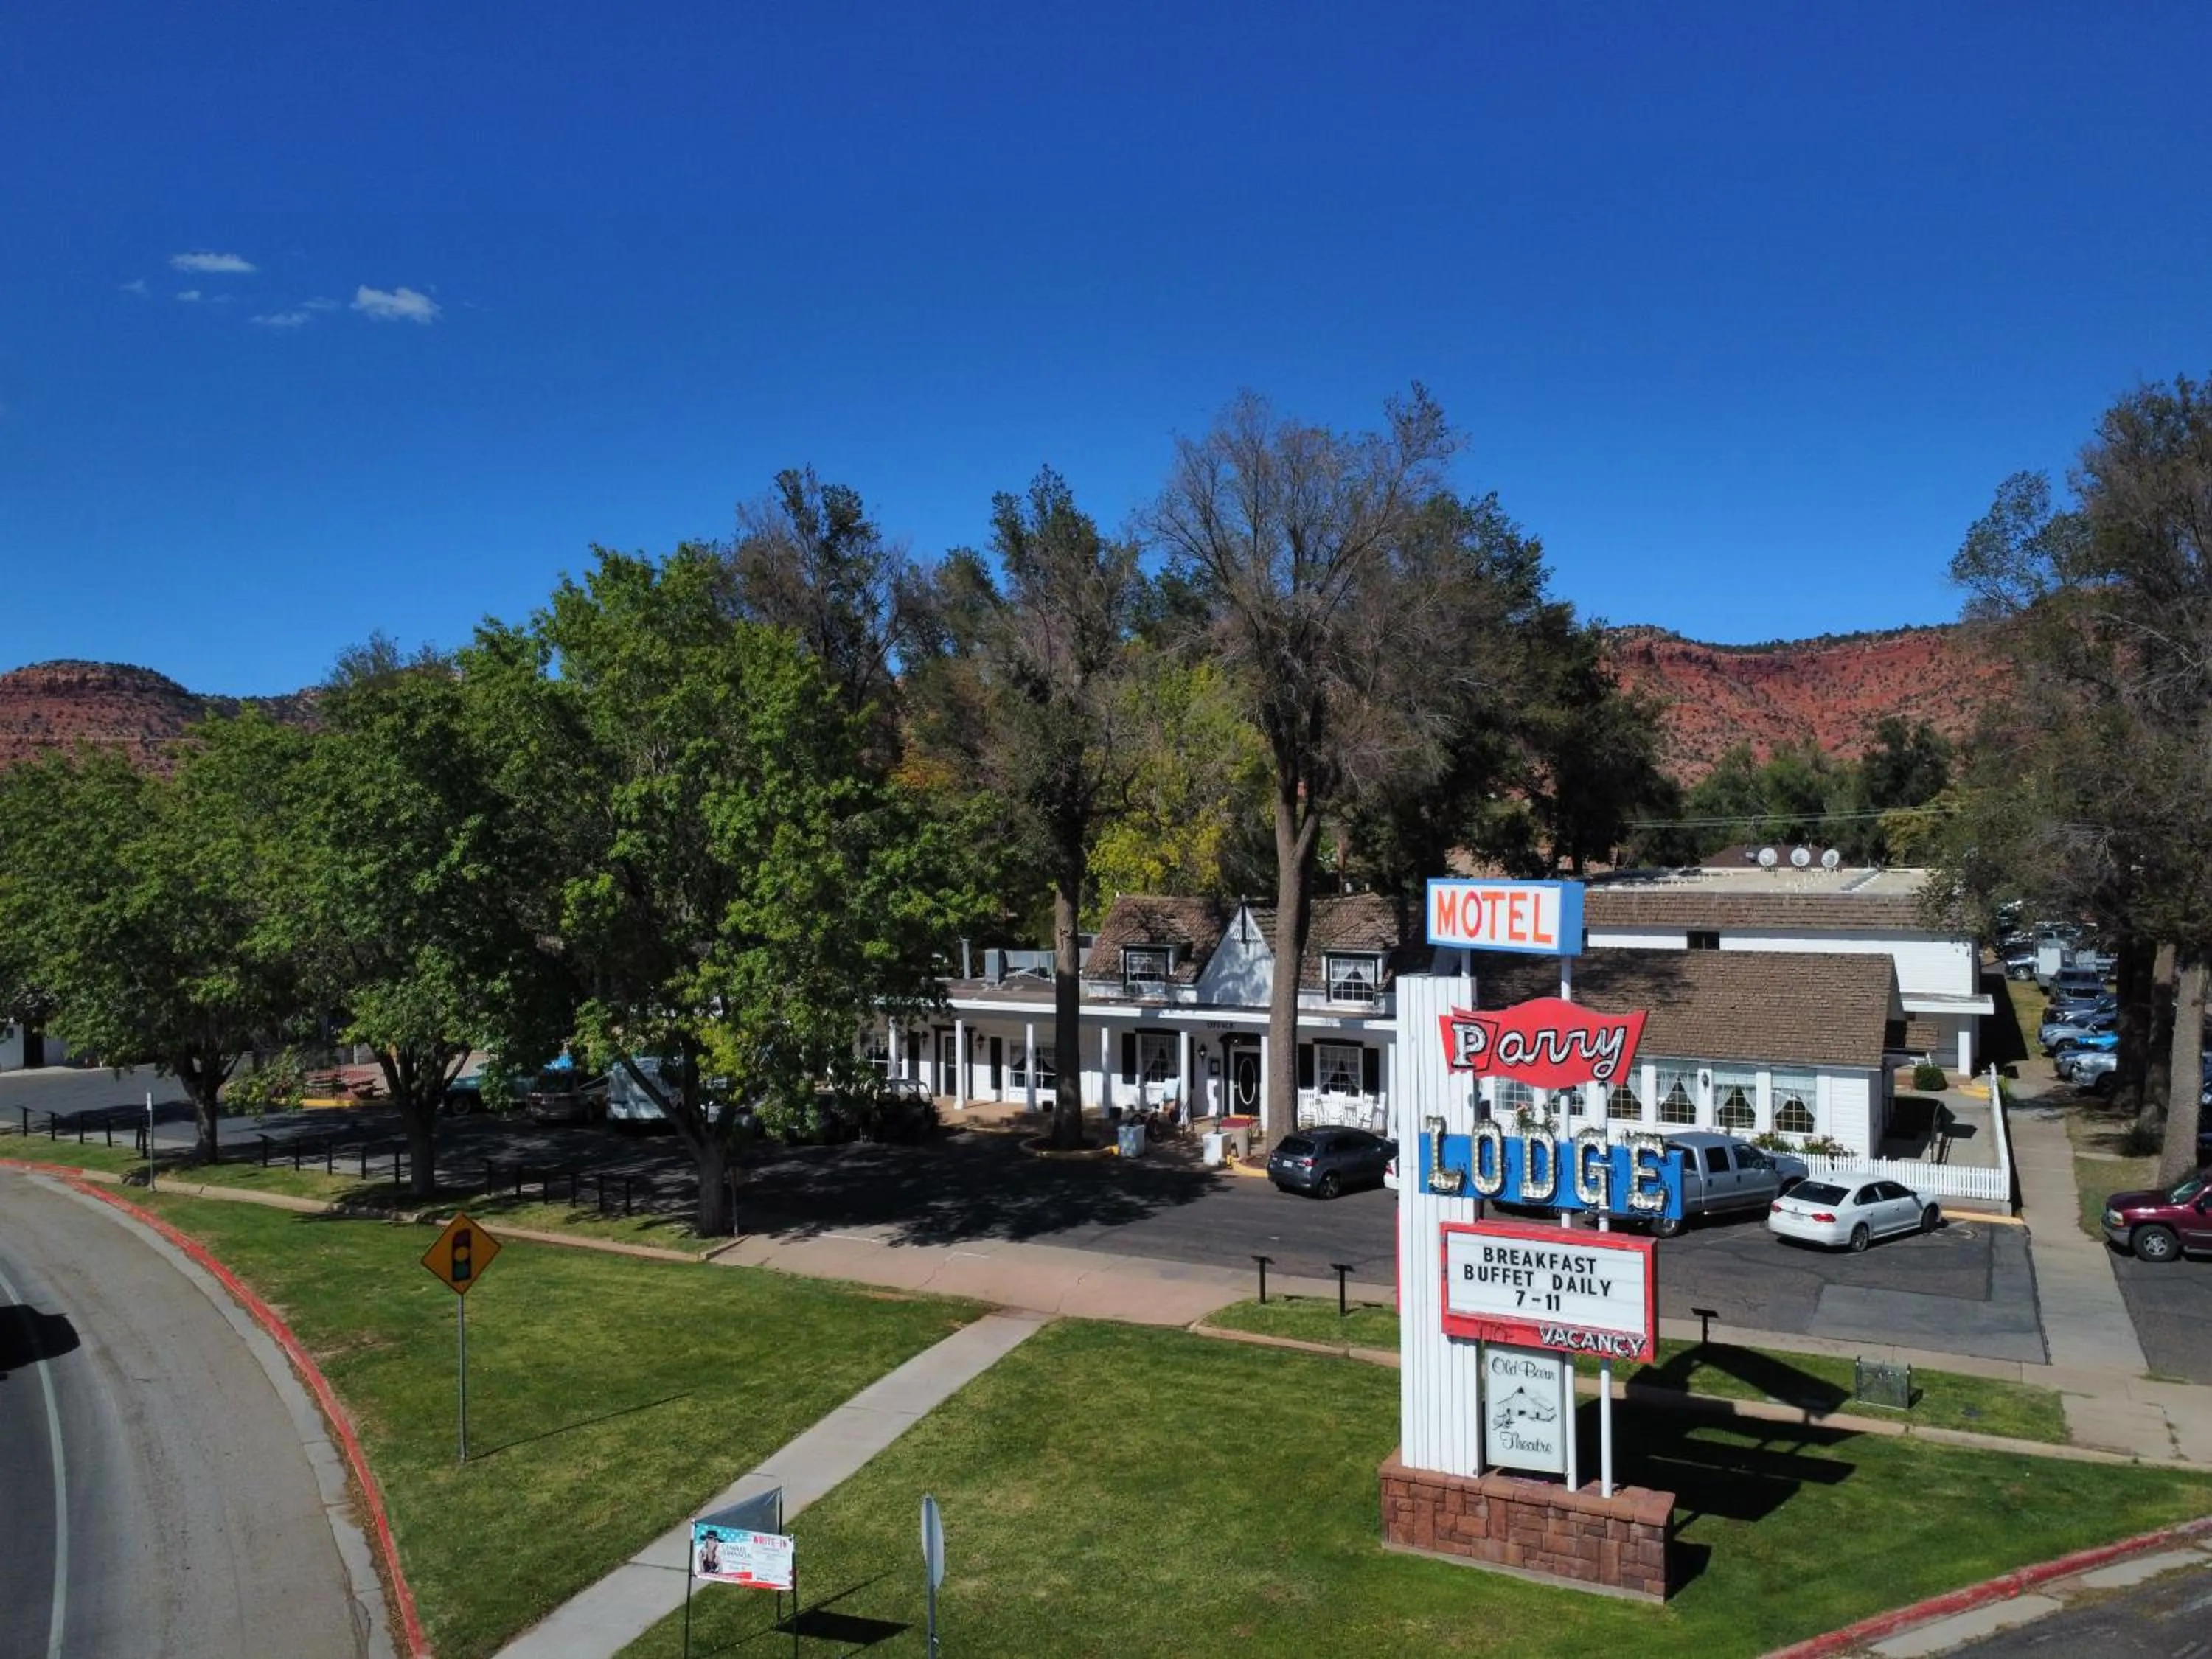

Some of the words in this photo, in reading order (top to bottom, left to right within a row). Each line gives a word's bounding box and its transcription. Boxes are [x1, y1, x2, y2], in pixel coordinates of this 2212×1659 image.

[1436, 890, 1552, 945] MOTEL
[1450, 1020, 1627, 1082] Parry
[1425, 1115, 1669, 1212] LODGE
[1483, 1246, 1597, 1275] BREAKFAST
[1464, 1264, 1534, 1287] BUFFET
[1552, 1273, 1613, 1298] DAILY
[1539, 1321, 1646, 1357] VACANCY
[1492, 1356, 1519, 1375] Old
[1499, 1431, 1552, 1454] Theatre
